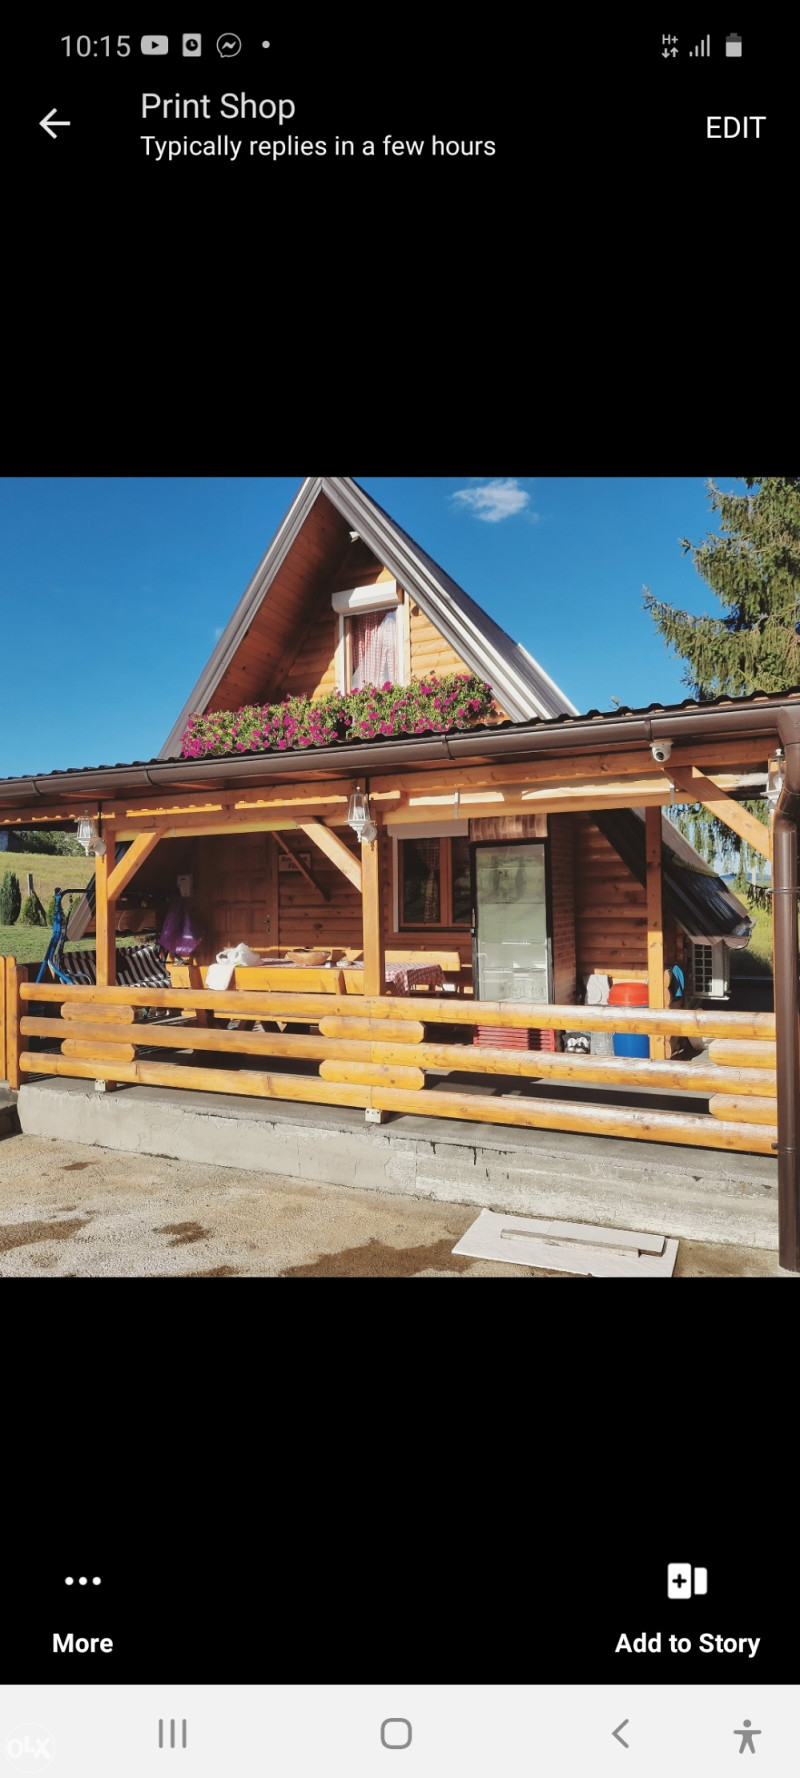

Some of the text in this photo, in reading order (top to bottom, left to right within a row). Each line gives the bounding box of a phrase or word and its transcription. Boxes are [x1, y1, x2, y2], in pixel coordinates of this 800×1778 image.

[60, 35, 131, 57] 10:15
[661, 34, 679, 45] H+
[141, 91, 296, 124] Print Shop
[706, 115, 767, 139] EDIT
[140, 134, 496, 162] Typically replies in a few hours
[52, 1632, 114, 1654] More
[614, 1631, 761, 1659] Add to Story
